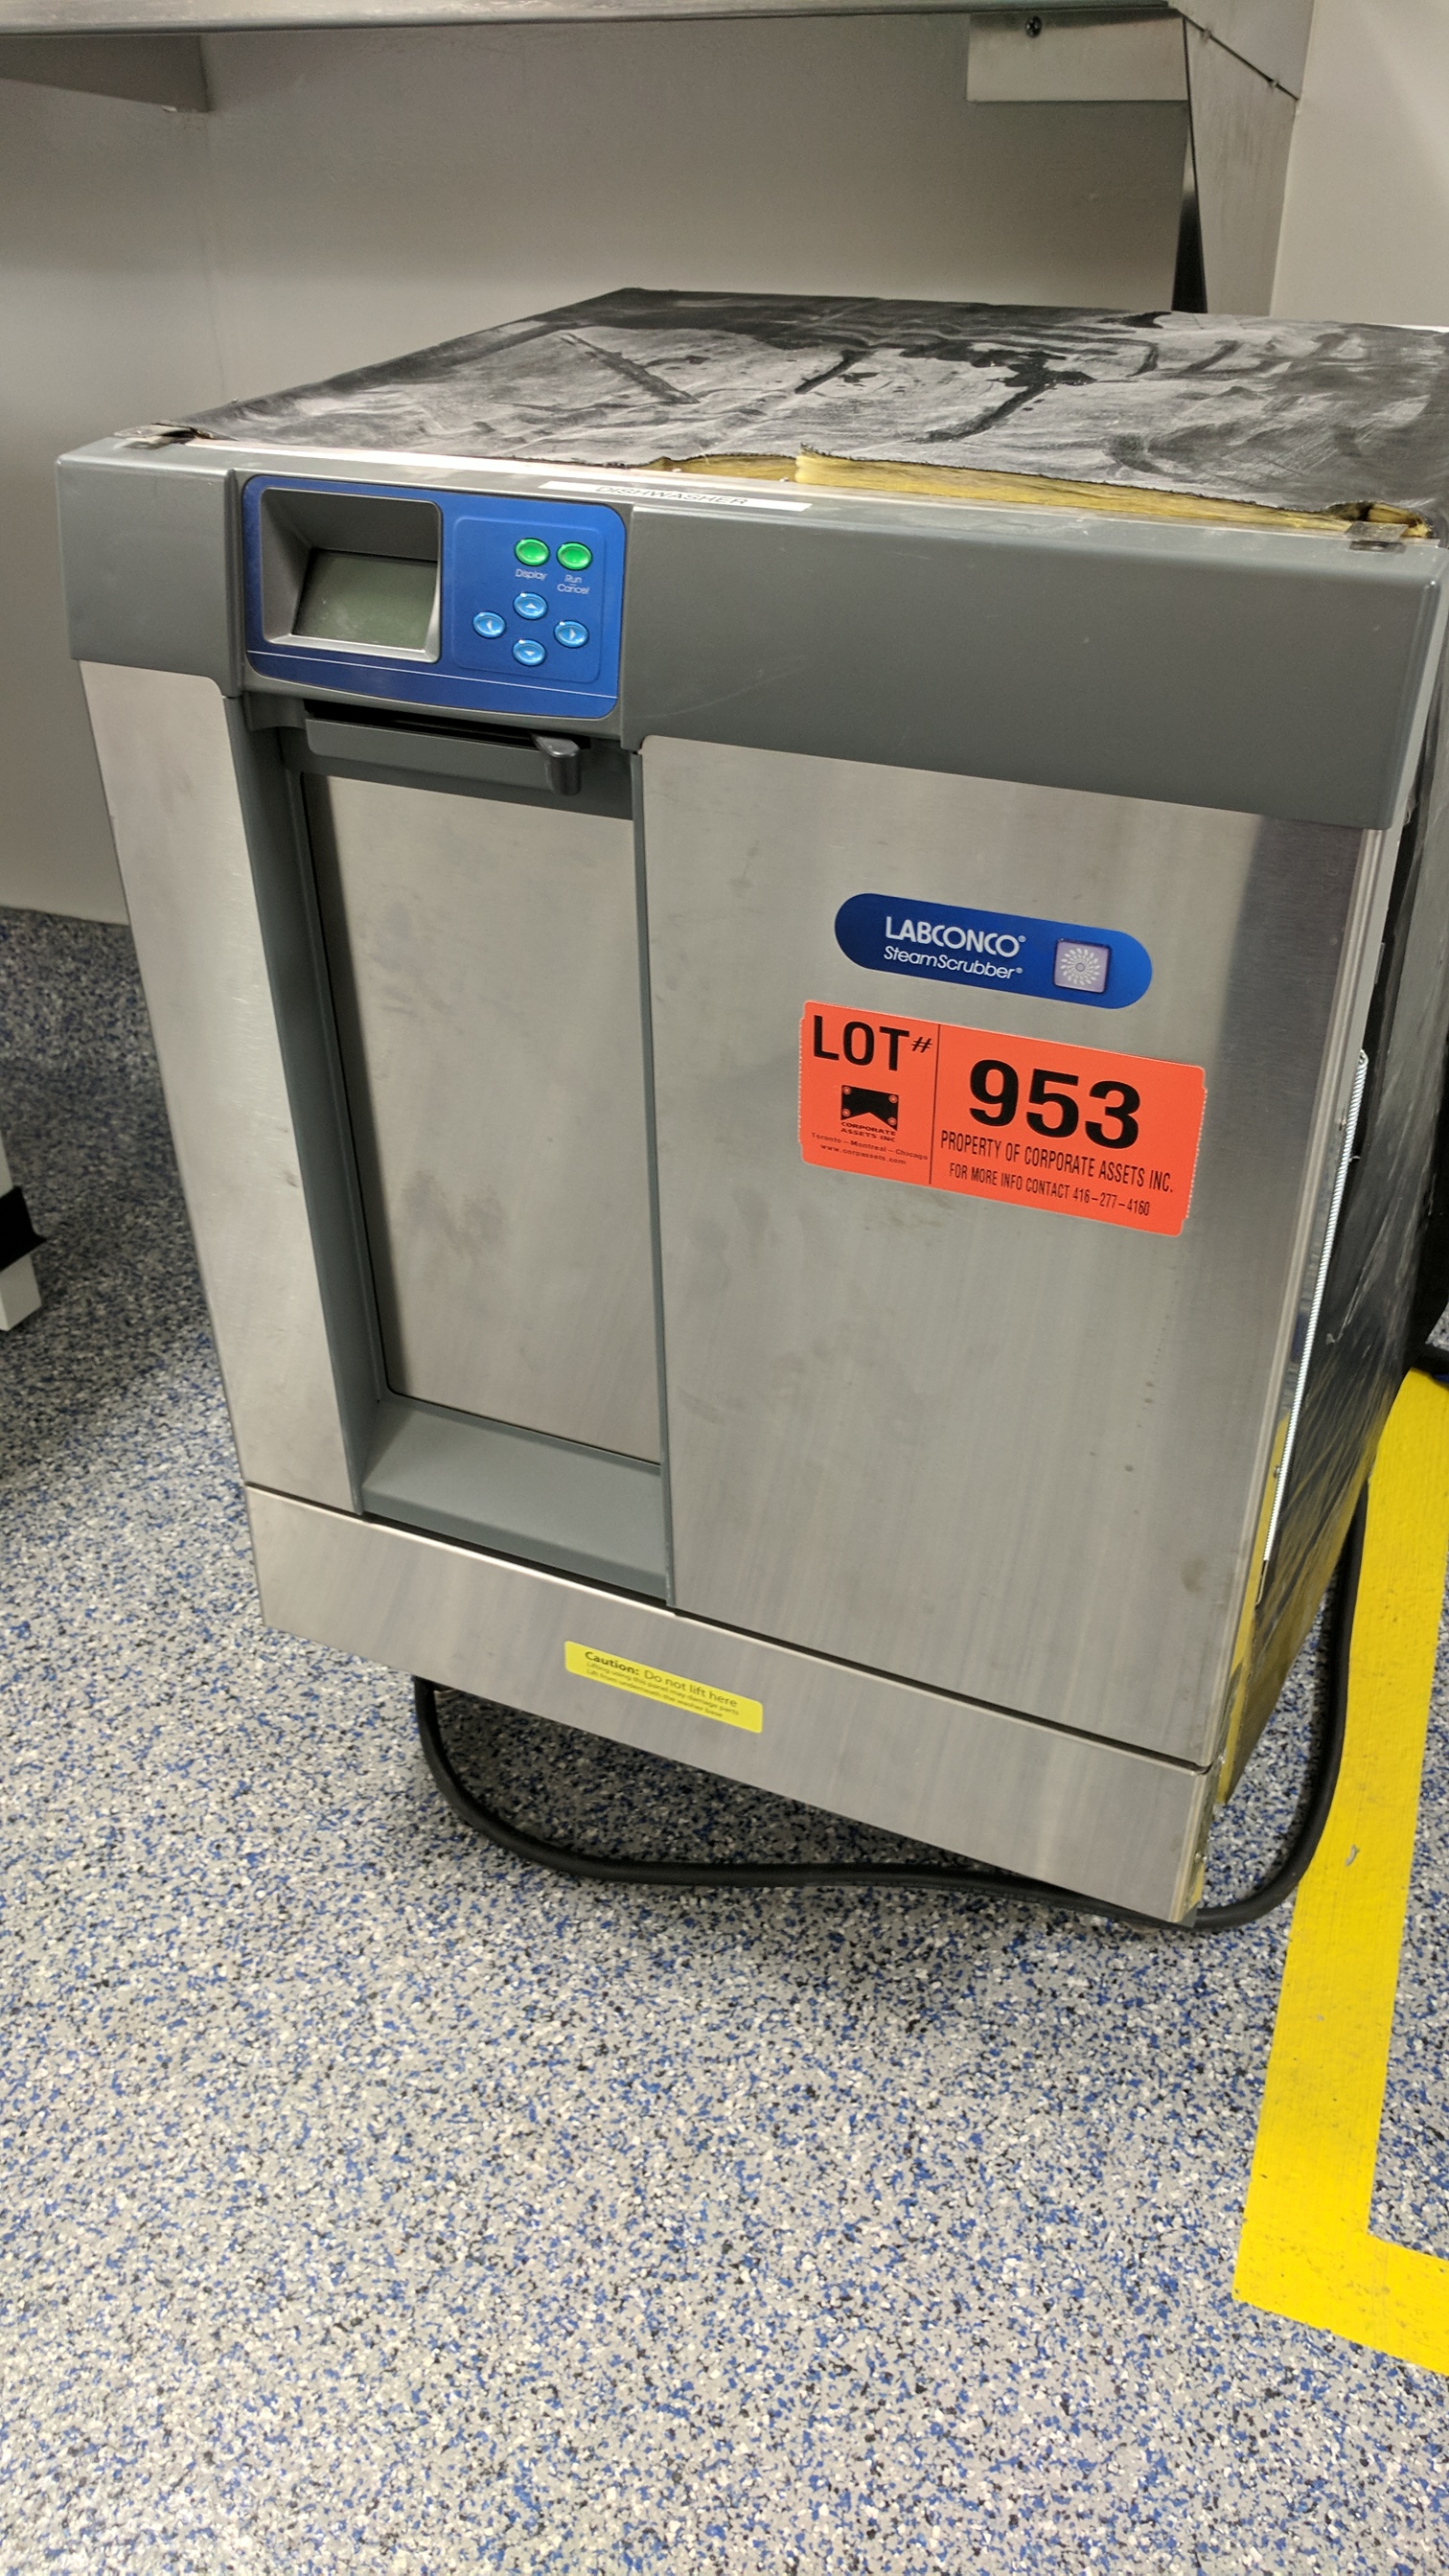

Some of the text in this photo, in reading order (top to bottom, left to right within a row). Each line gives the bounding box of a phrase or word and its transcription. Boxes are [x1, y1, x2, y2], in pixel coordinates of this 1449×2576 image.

[595, 486, 748, 504] DISHWASHER
[515, 568, 547, 581] Display
[564, 574, 583, 584] Run
[557, 584, 590, 594] Cancel
[969, 1059, 1140, 1149] 953
[841, 1121, 896, 1137] CORPORATE
[841, 1128, 877, 1139] ASSETS
[812, 1132, 841, 1143] Toronto
[850, 1139, 887, 1153] Montreal
[895, 1148, 929, 1161] Chicago
[820, 1144, 907, 1164] www.corpassets.com
[940, 1130, 1173, 1193] PROPERTY OF CORPORATE ASSETS INC.
[949, 1162, 968, 1180] FOR
[971, 1166, 998, 1185] MORE
[1000, 1172, 1023, 1190] INFO
[1025, 1177, 1070, 1199] CONTACT
[585, 1651, 738, 1708] Caution: Do not lift here
